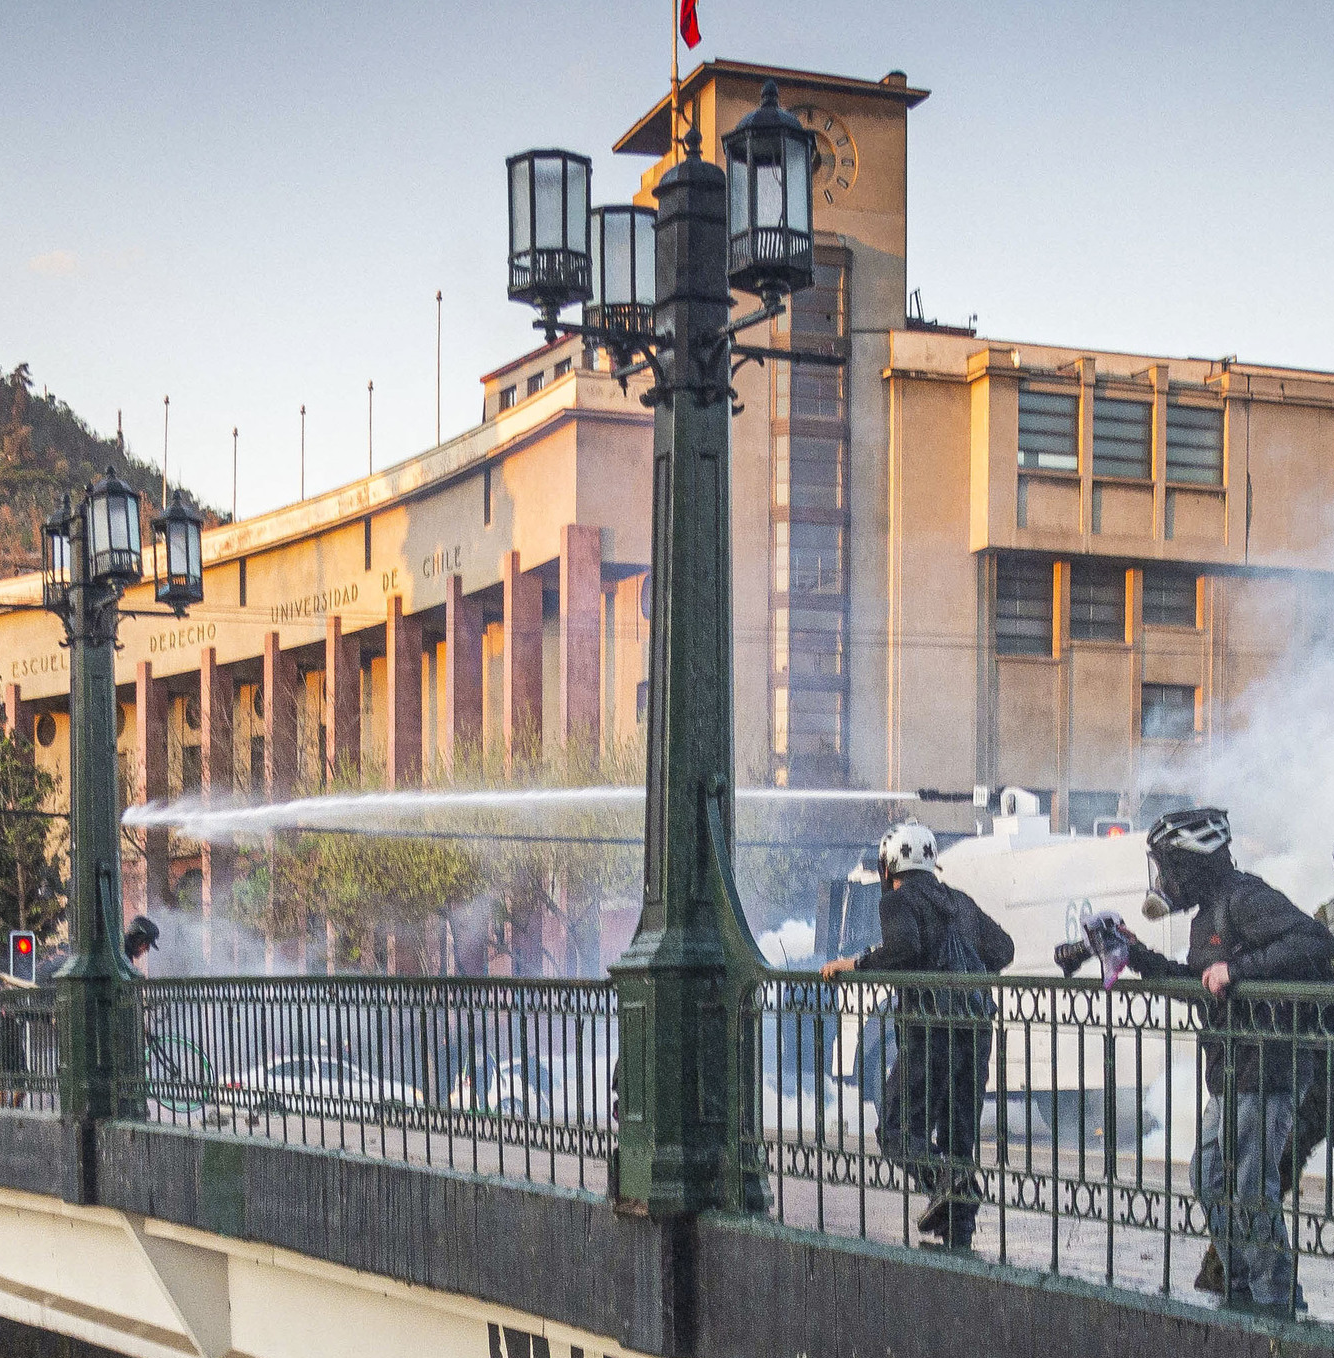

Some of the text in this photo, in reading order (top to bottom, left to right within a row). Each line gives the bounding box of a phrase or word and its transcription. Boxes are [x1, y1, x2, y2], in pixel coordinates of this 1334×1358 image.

[12, 545, 462, 678] ESCUEL DERECHO UNIVERSIDAD DE CHILE
